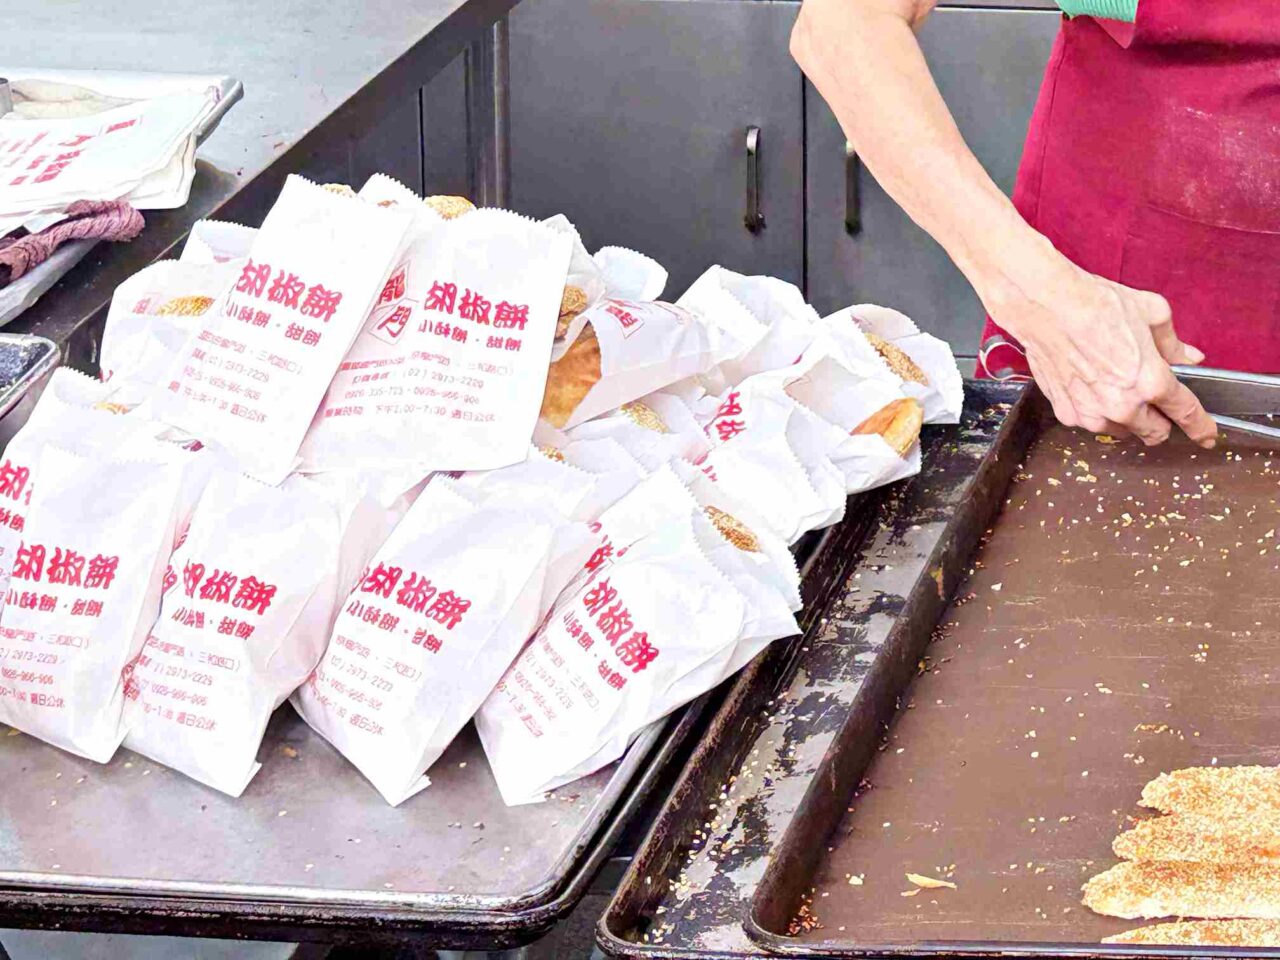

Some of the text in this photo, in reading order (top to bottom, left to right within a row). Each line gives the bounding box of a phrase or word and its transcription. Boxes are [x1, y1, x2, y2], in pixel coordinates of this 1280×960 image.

[236, 258, 342, 322] 胡椒餅
[424, 280, 529, 330] 胡椒餅
[0, 459, 34, 506] 胡
[12, 541, 119, 589] 胡椒餅
[361, 561, 472, 630] 胡椒餅
[583, 577, 660, 674] 胡椒餅
